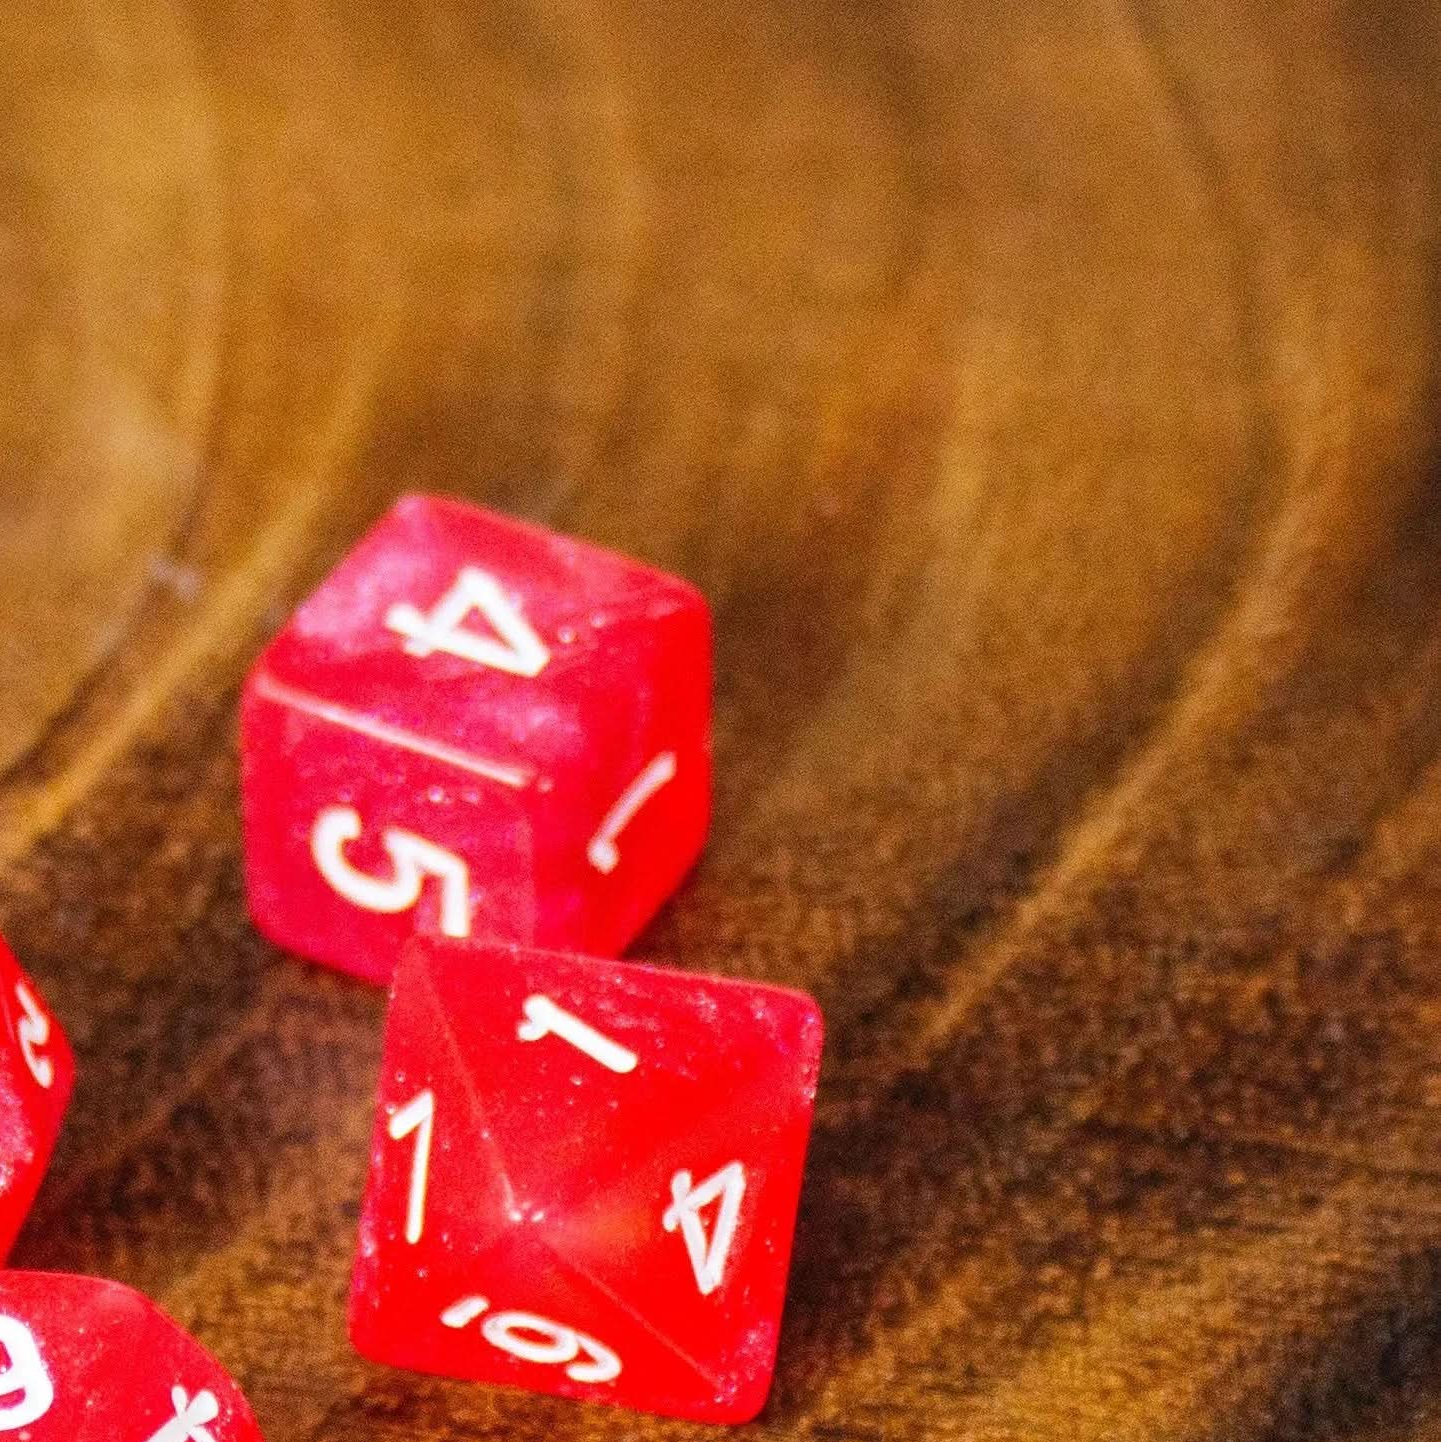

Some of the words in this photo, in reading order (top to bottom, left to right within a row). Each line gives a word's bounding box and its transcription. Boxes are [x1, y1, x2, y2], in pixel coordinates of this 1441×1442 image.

[385, 567, 550, 676] 4
[311, 808, 471, 938] 5
[518, 995, 638, 1073] 1
[663, 1162, 747, 1295] 4
